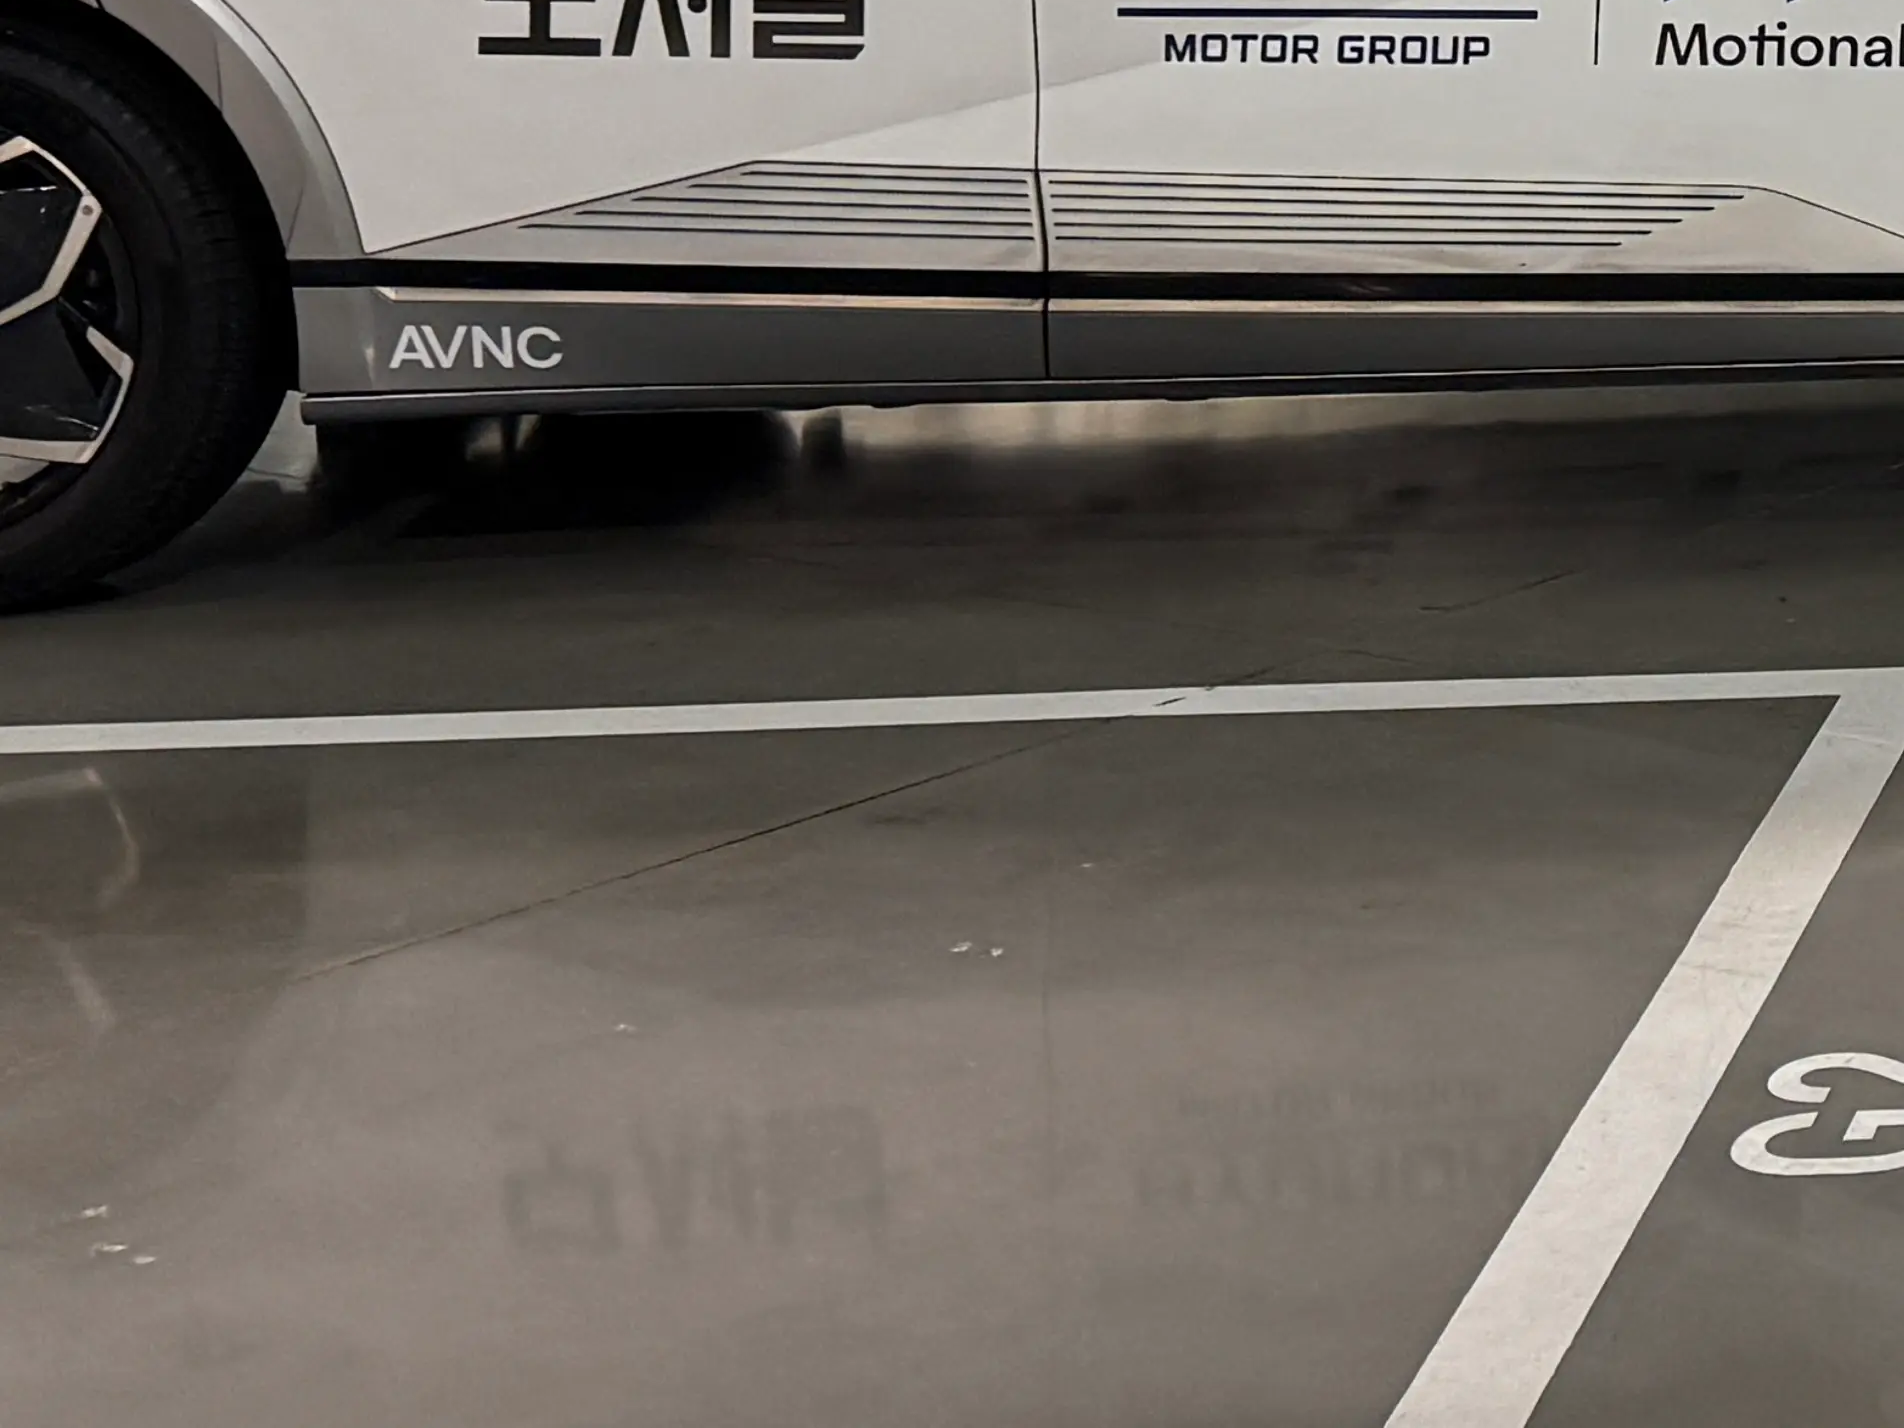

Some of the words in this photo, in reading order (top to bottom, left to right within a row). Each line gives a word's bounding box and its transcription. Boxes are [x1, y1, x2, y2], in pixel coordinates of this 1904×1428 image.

[1164, 33, 1319, 65] MOTOR
[1337, 35, 1490, 65] GROUP
[389, 324, 564, 370] AVNC
